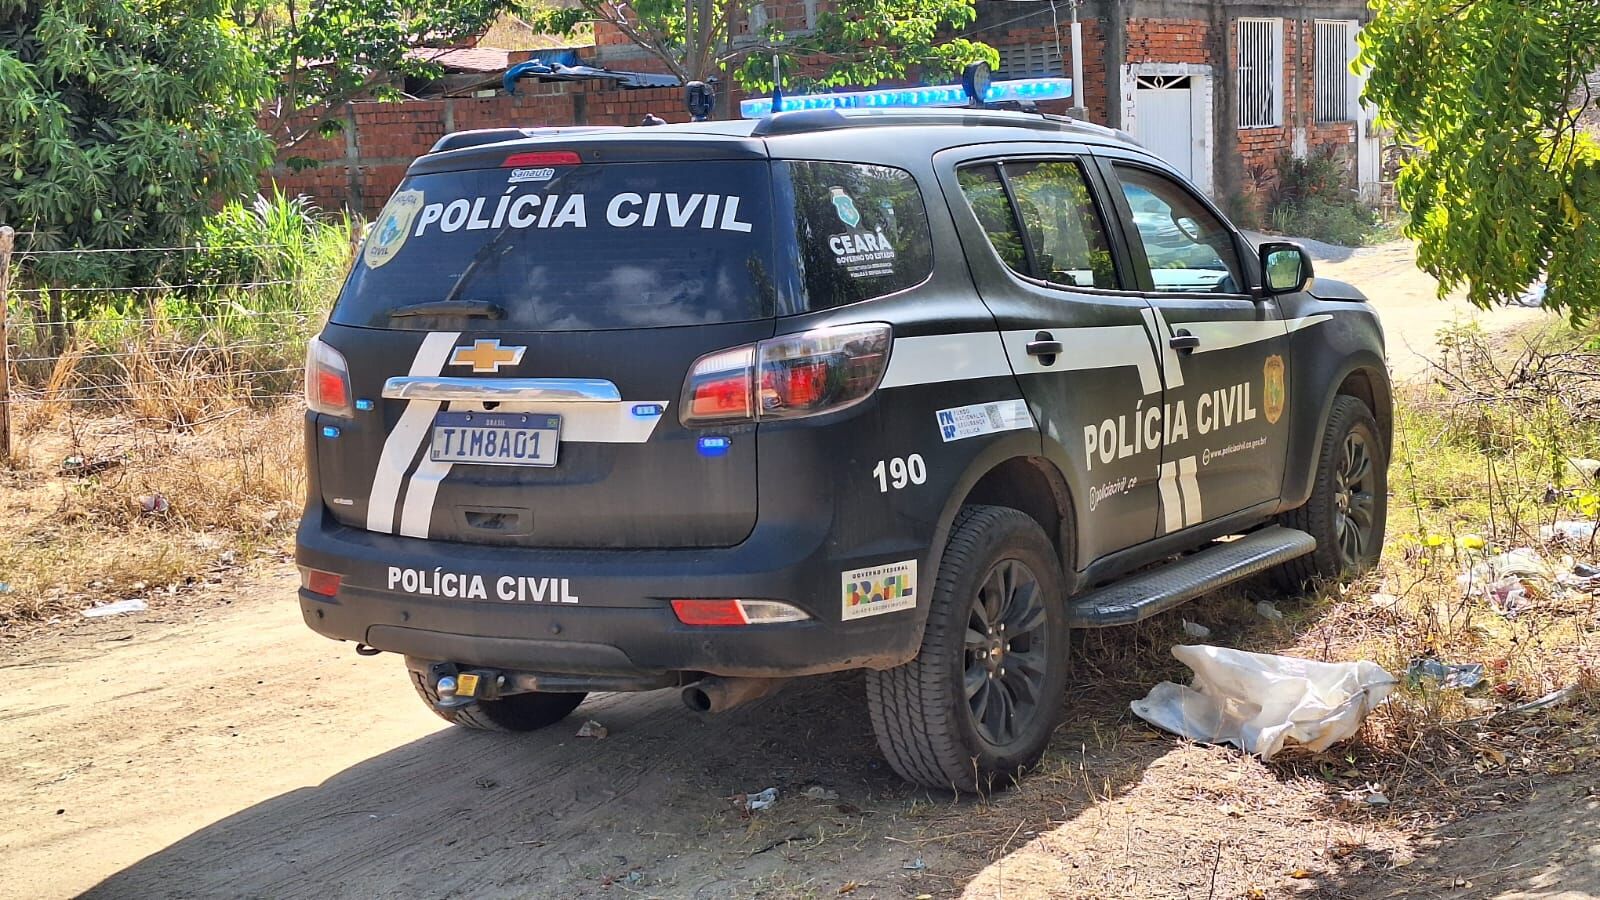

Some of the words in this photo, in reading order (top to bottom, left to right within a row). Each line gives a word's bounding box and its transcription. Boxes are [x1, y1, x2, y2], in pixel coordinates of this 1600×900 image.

[512, 168, 554, 178] Sanauto
[414, 186, 587, 237] POLÍCIA
[606, 192, 752, 233] CIVIL
[829, 226, 893, 256] CEARÁ
[836, 255, 865, 264] GOVERNO
[865, 253, 874, 261] DO
[485, 418, 506, 427] BRASIL
[938, 410, 955, 426] FN
[943, 424, 956, 439] SP
[1084, 399, 1189, 471] POLÍCIA
[1196, 381, 1256, 435] CIVIL
[444, 428, 541, 459] TIM8A01
[873, 453, 927, 493] 190
[388, 566, 487, 600] POLÍCIA
[496, 575, 579, 604] CIVIL
[852, 570, 881, 579] GOVERNO
[882, 564, 909, 574] FEDERAL
[846, 574, 913, 608] BRASIL
